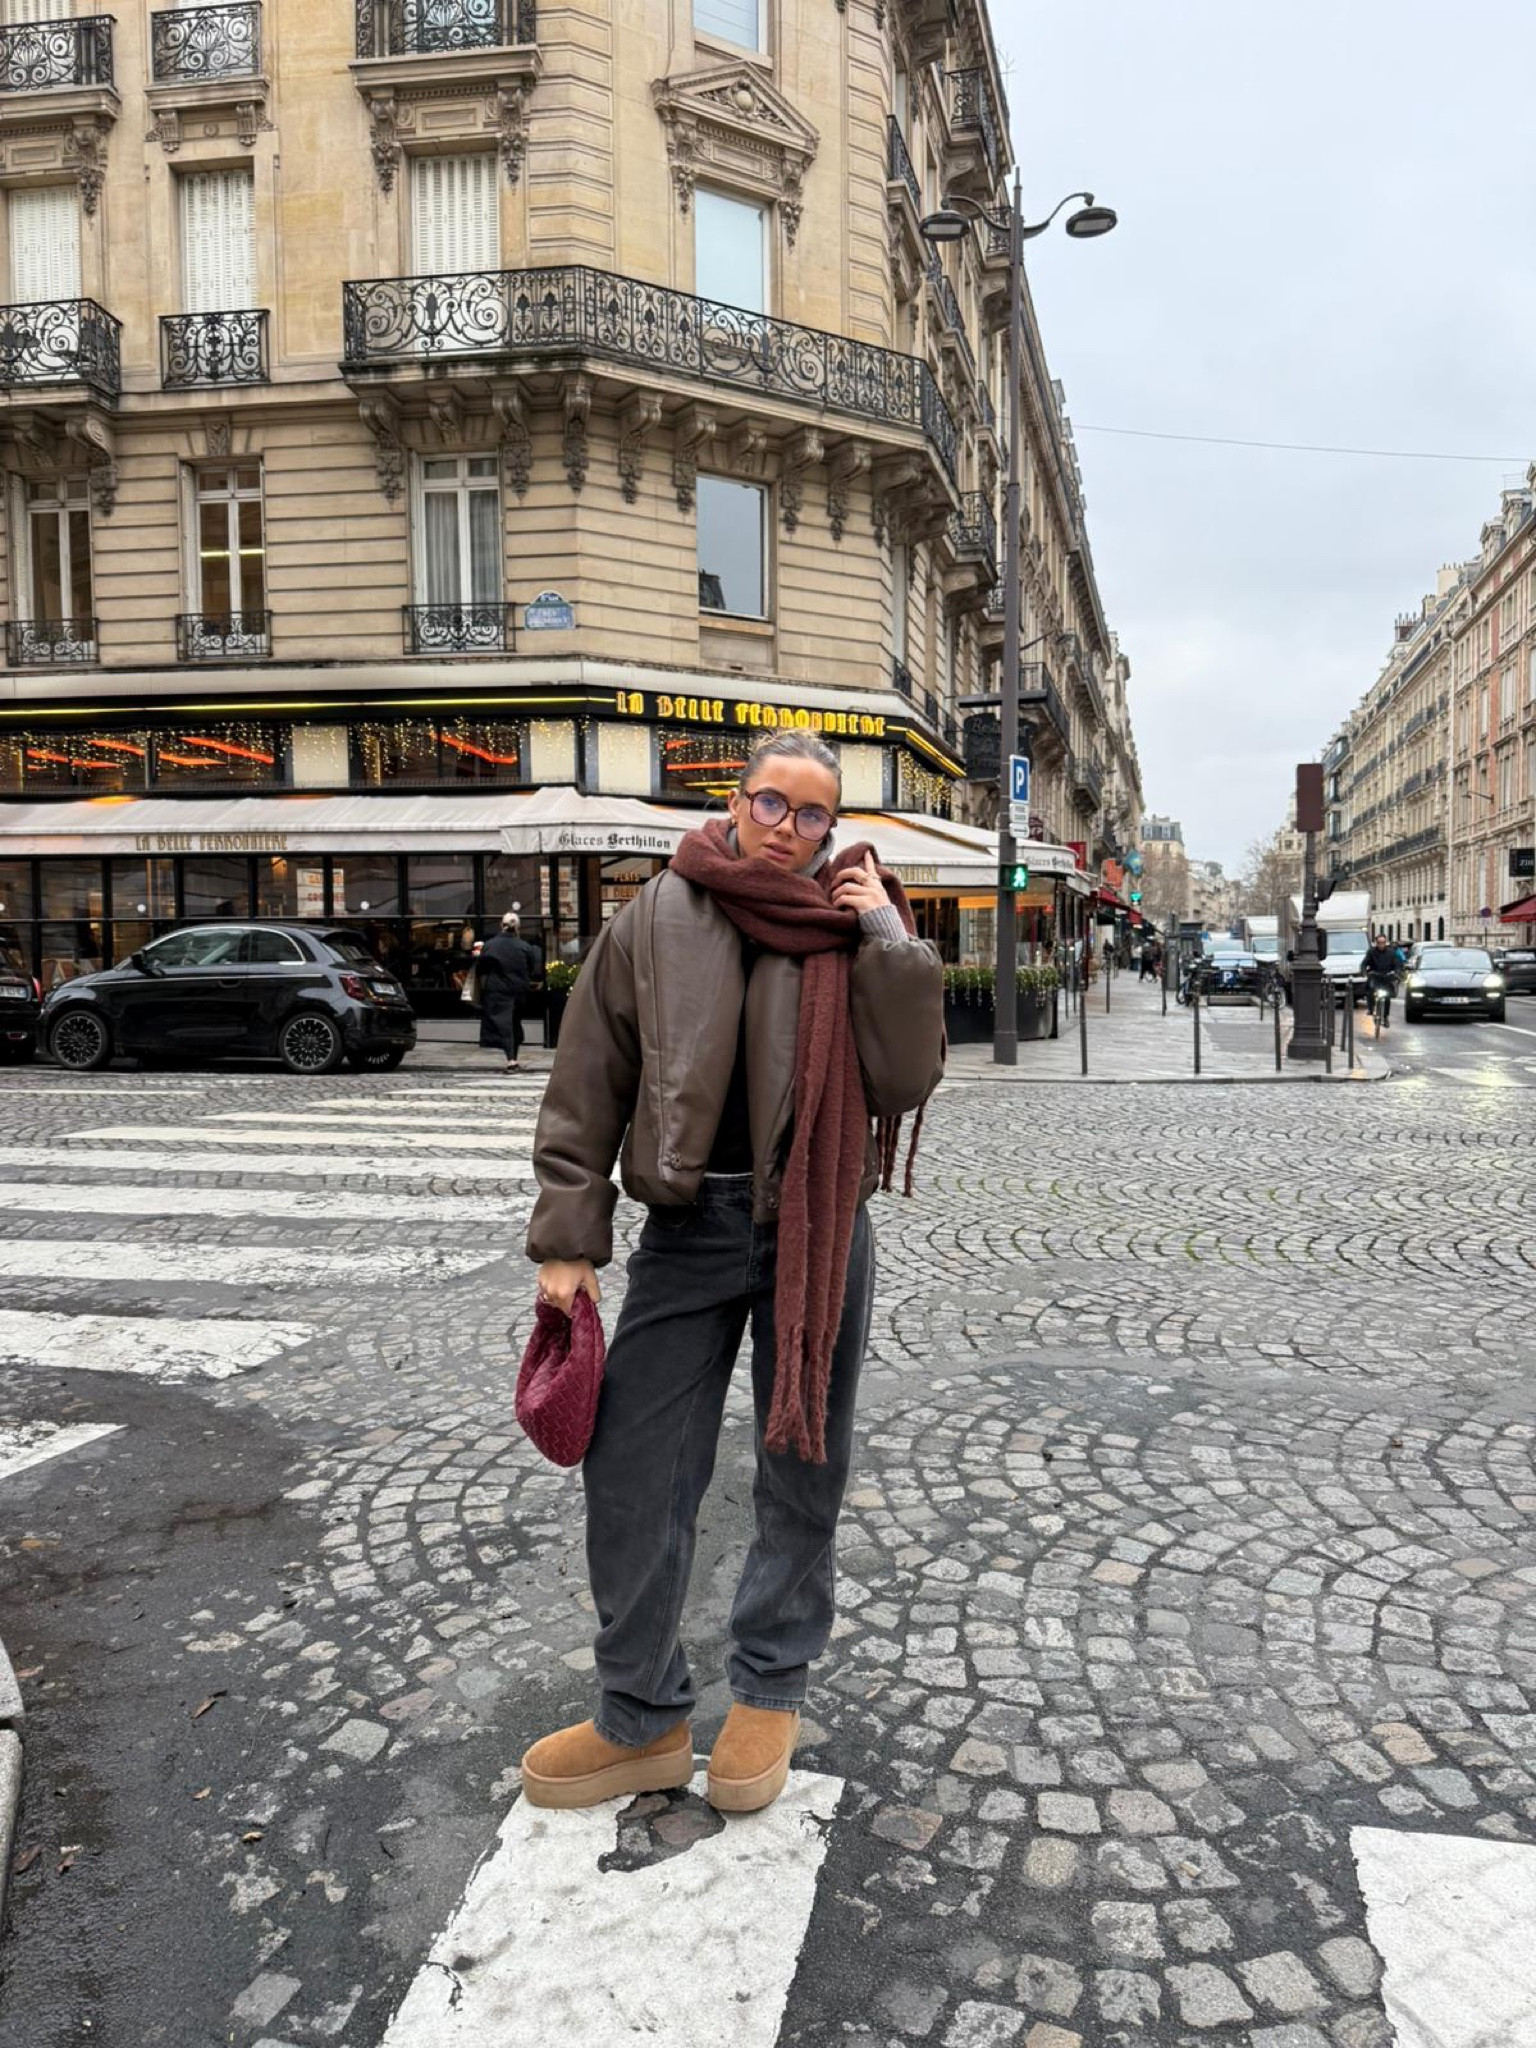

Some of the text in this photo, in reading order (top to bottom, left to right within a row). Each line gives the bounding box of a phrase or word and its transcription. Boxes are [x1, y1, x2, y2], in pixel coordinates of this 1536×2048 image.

[616, 691, 644, 714] LA
[657, 695, 724, 722] BELLE
[1016, 766, 1024, 795] P
[158, 835, 192, 850] BELLE
[559, 830, 670, 849] Glaces Berthillon
[1223, 971, 1233, 983] P
